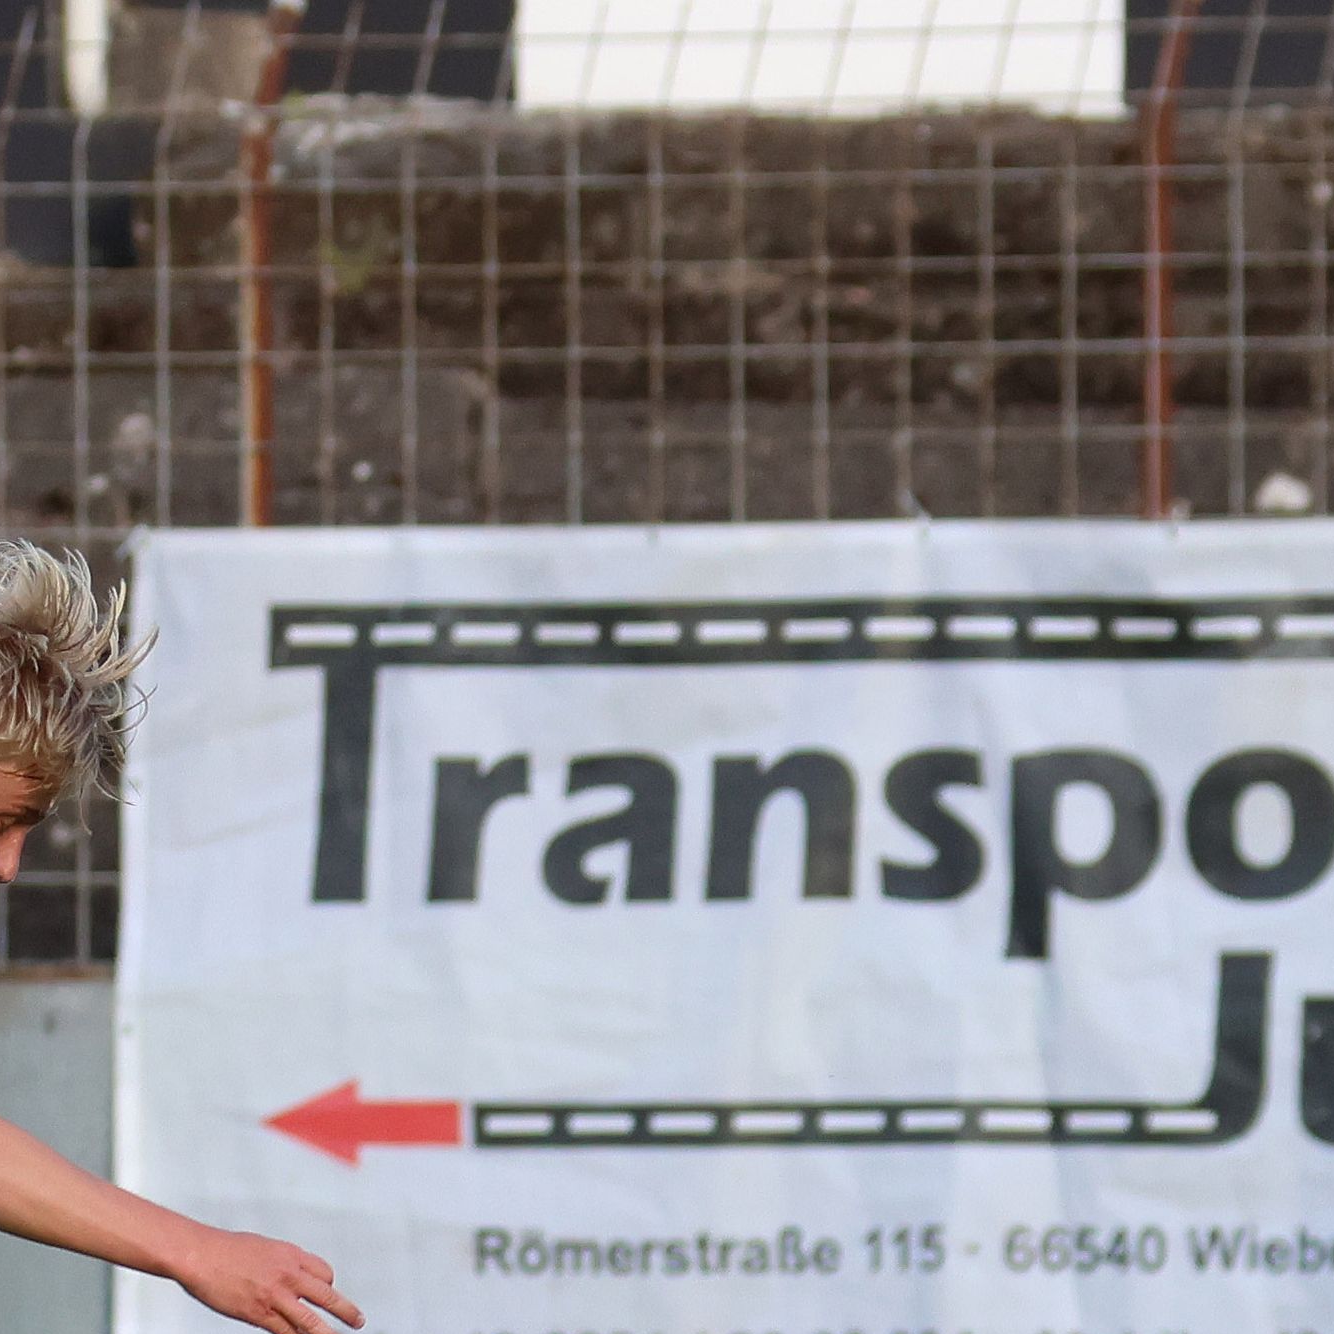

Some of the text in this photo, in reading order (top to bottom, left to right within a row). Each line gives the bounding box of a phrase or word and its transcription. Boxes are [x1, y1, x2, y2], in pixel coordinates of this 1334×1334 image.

[471, 1225, 842, 1277] Römerstraße
[865, 1223, 946, 1275] 115
[1003, 1224, 1168, 1275] 66540
